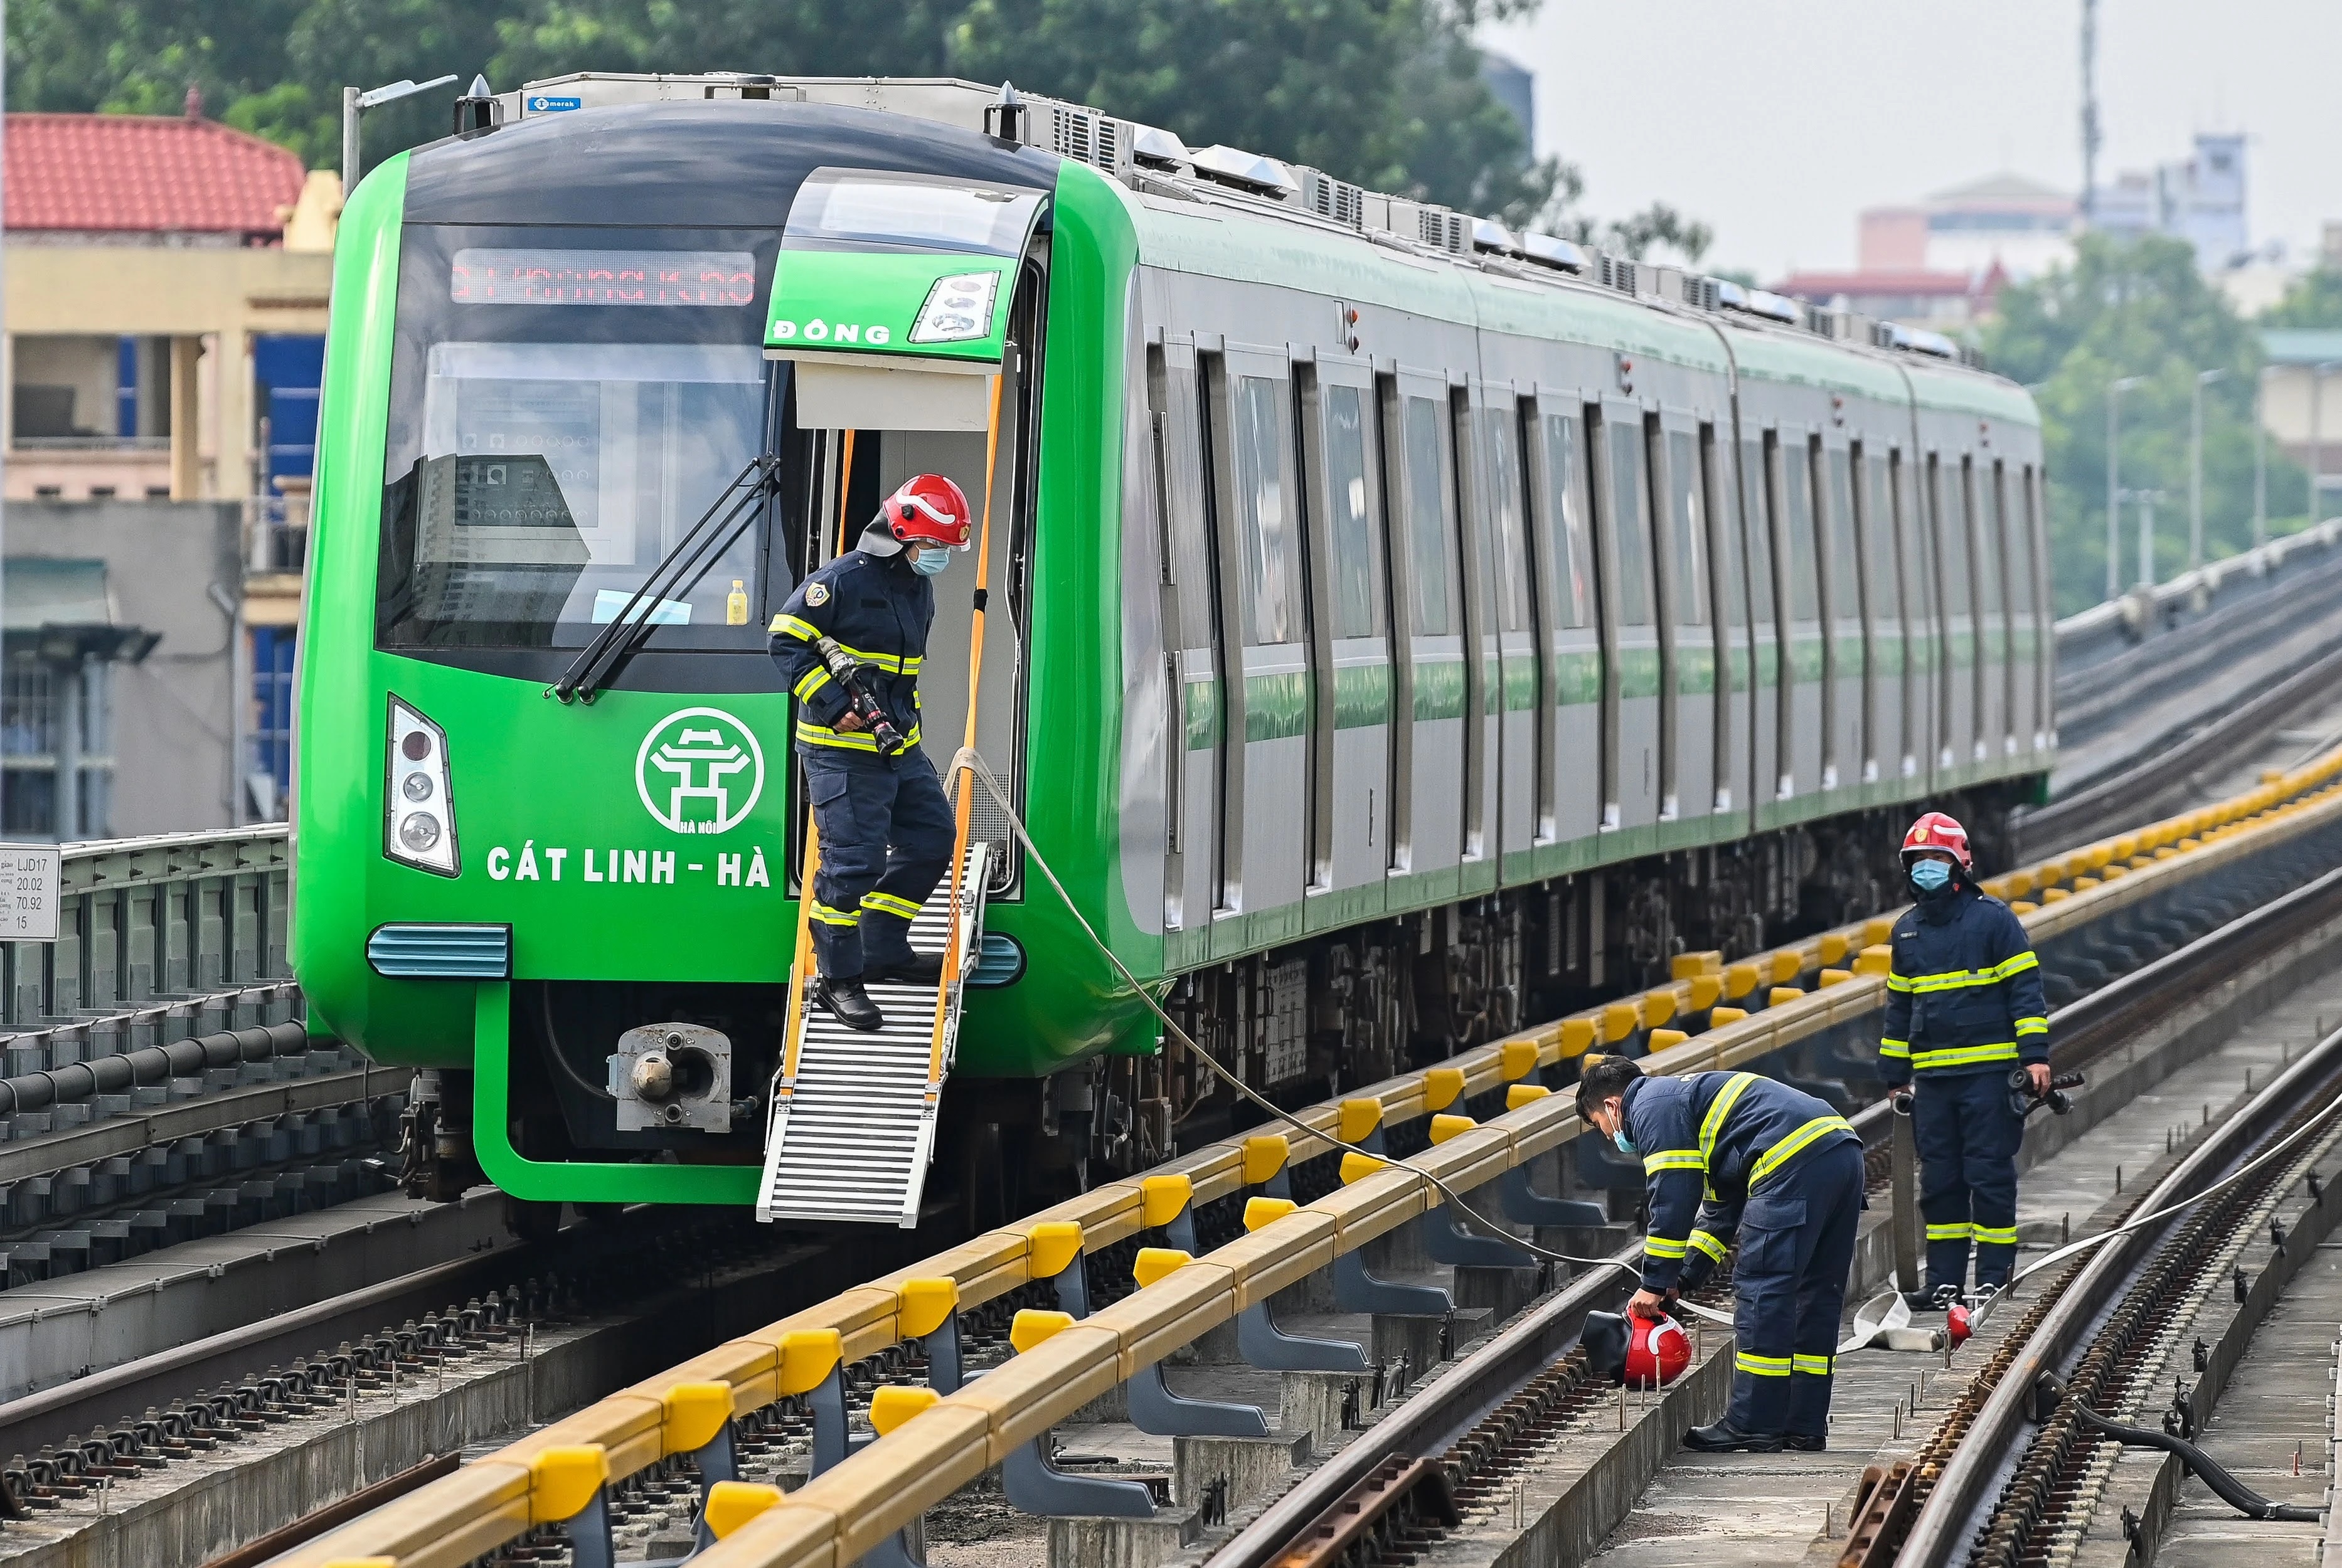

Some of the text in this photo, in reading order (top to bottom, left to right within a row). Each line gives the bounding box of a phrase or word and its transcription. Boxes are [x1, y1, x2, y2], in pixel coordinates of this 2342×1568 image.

[772, 318, 890, 344] ĐÔNG
[680, 819, 696, 834] HÀ
[18, 858, 47, 871] LJD17
[487, 839, 770, 887] CÁT LINH - HÀ
[17, 877, 42, 891] 20.02
[16, 896, 41, 910] 70.92
[16, 916, 27, 929] 15
